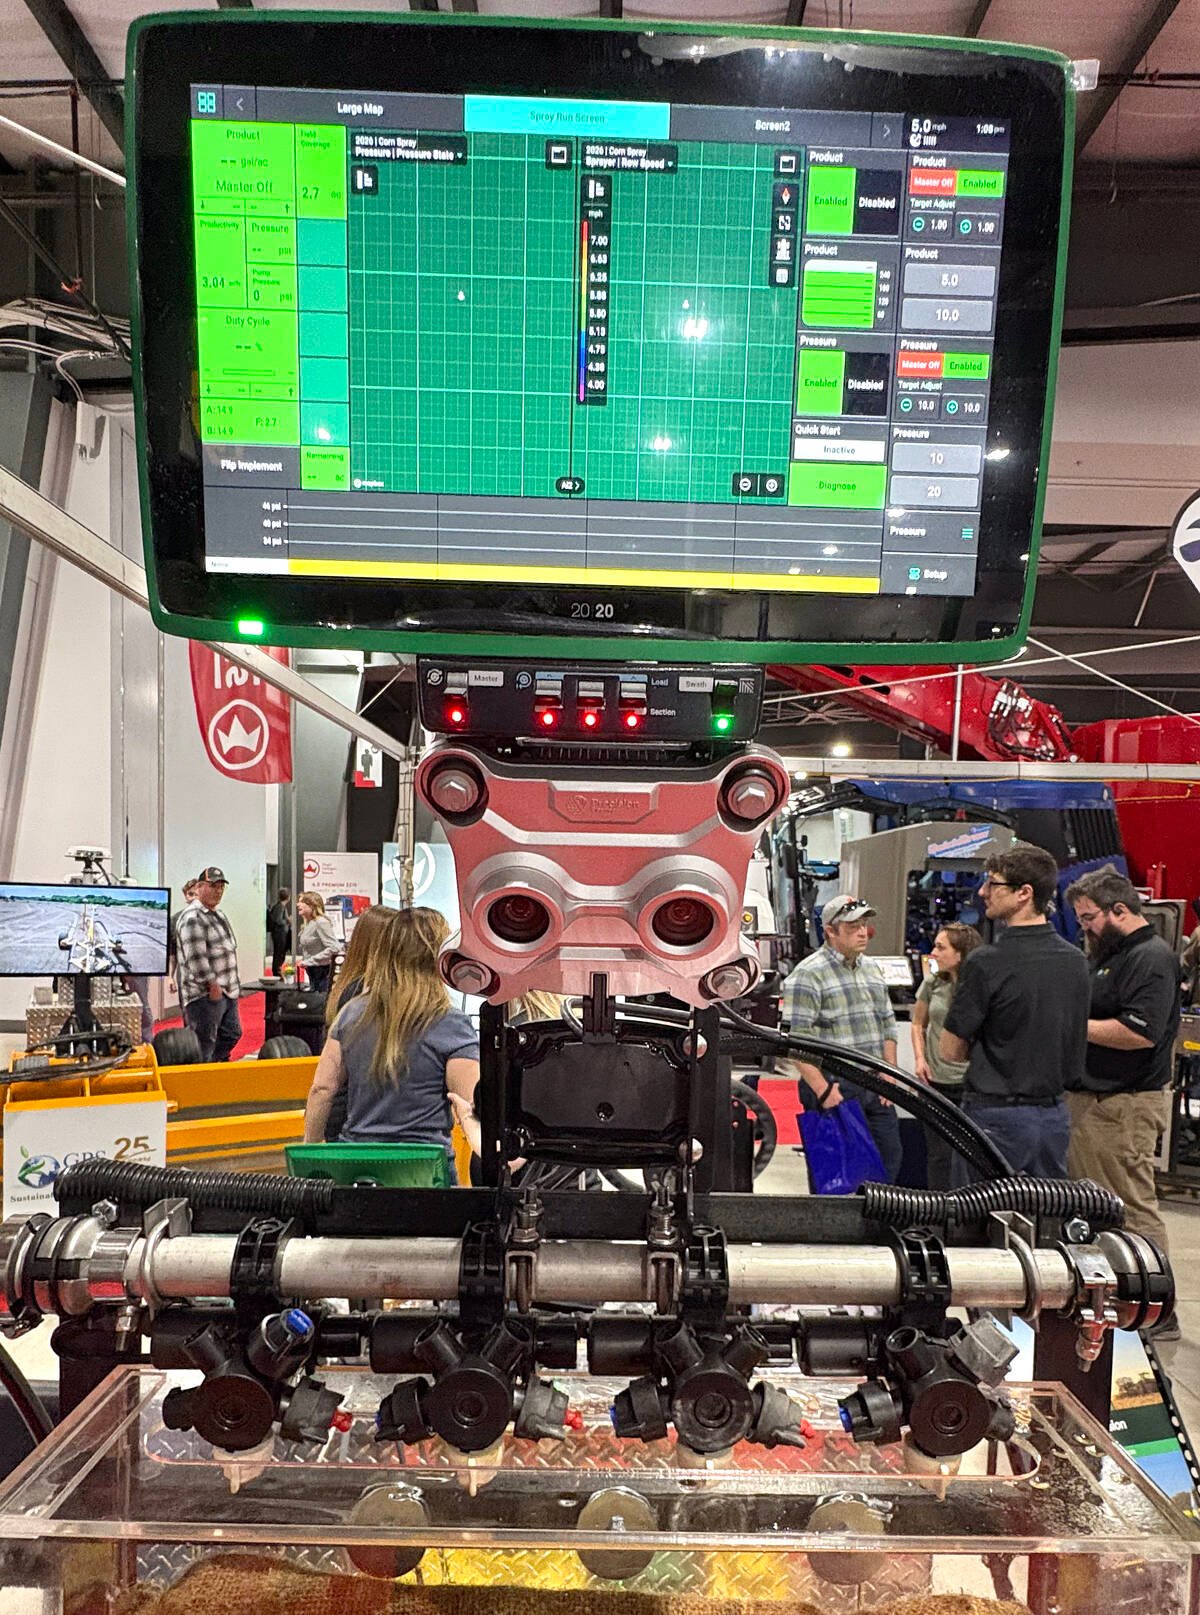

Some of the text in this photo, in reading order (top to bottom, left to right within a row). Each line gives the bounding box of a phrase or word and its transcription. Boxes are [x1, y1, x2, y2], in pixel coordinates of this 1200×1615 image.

[337, 101, 384, 117] Large Map
[530, 110, 605, 124] Spray Run Screen
[755, 119, 791, 133] Screen2
[911, 119, 931, 133] 5.0
[226, 128, 260, 140] Product
[397, 138, 417, 149] Spray
[355, 146, 392, 158] Pressure
[396, 149, 432, 160] Pressure
[585, 145, 604, 156] 2026
[627, 147, 647, 158] Spray
[809, 151, 843, 163] Product
[585, 155, 616, 169] Sprayer
[640, 158, 665, 170] Speed
[912, 156, 947, 168] Product
[215, 180, 273, 193] Master Off
[913, 177, 954, 188] Master Off
[963, 179, 997, 189] Enabled
[301, 186, 320, 200] 2.7
[814, 196, 848, 206] Enabled
[858, 197, 896, 209] Disabled
[910, 198, 956, 210] Target Adjust
[588, 210, 604, 219] mph
[251, 222, 289, 234] Pressure
[930, 219, 948, 231] 1.00
[977, 222, 995, 233] 1.00
[591, 235, 609, 247] 7.00
[804, 244, 838, 256] Product
[905, 248, 939, 260] Product
[941, 273, 959, 287] 5.0
[253, 289, 260, 302] 0
[225, 315, 270, 328] Duty Cycle
[936, 309, 960, 322] 10.0
[799, 335, 838, 347] Pressure
[900, 340, 938, 351] Pressure
[901, 359, 941, 371] Master Off
[949, 361, 983, 371] Enabled
[804, 378, 838, 388] Enabled
[847, 379, 885, 391] Disabled
[898, 380, 943, 393] Target Adjust
[917, 400, 935, 411] 10.0
[963, 402, 981, 413] 10.0
[795, 424, 841, 436] Quick Start
[893, 428, 930, 439] Pressure
[823, 445, 856, 455] Inactive
[930, 452, 944, 465] 10
[220, 459, 283, 472] Flip Implement
[818, 480, 857, 493] Diagnose
[927, 485, 942, 498] 20
[889, 525, 926, 537] Pressure
[923, 568, 947, 580] Setup
[473, 673, 499, 683] Master
[651, 677, 669, 687] Load
[650, 707, 677, 717] Section
[9, 1192, 54, 1203] Sustaina
